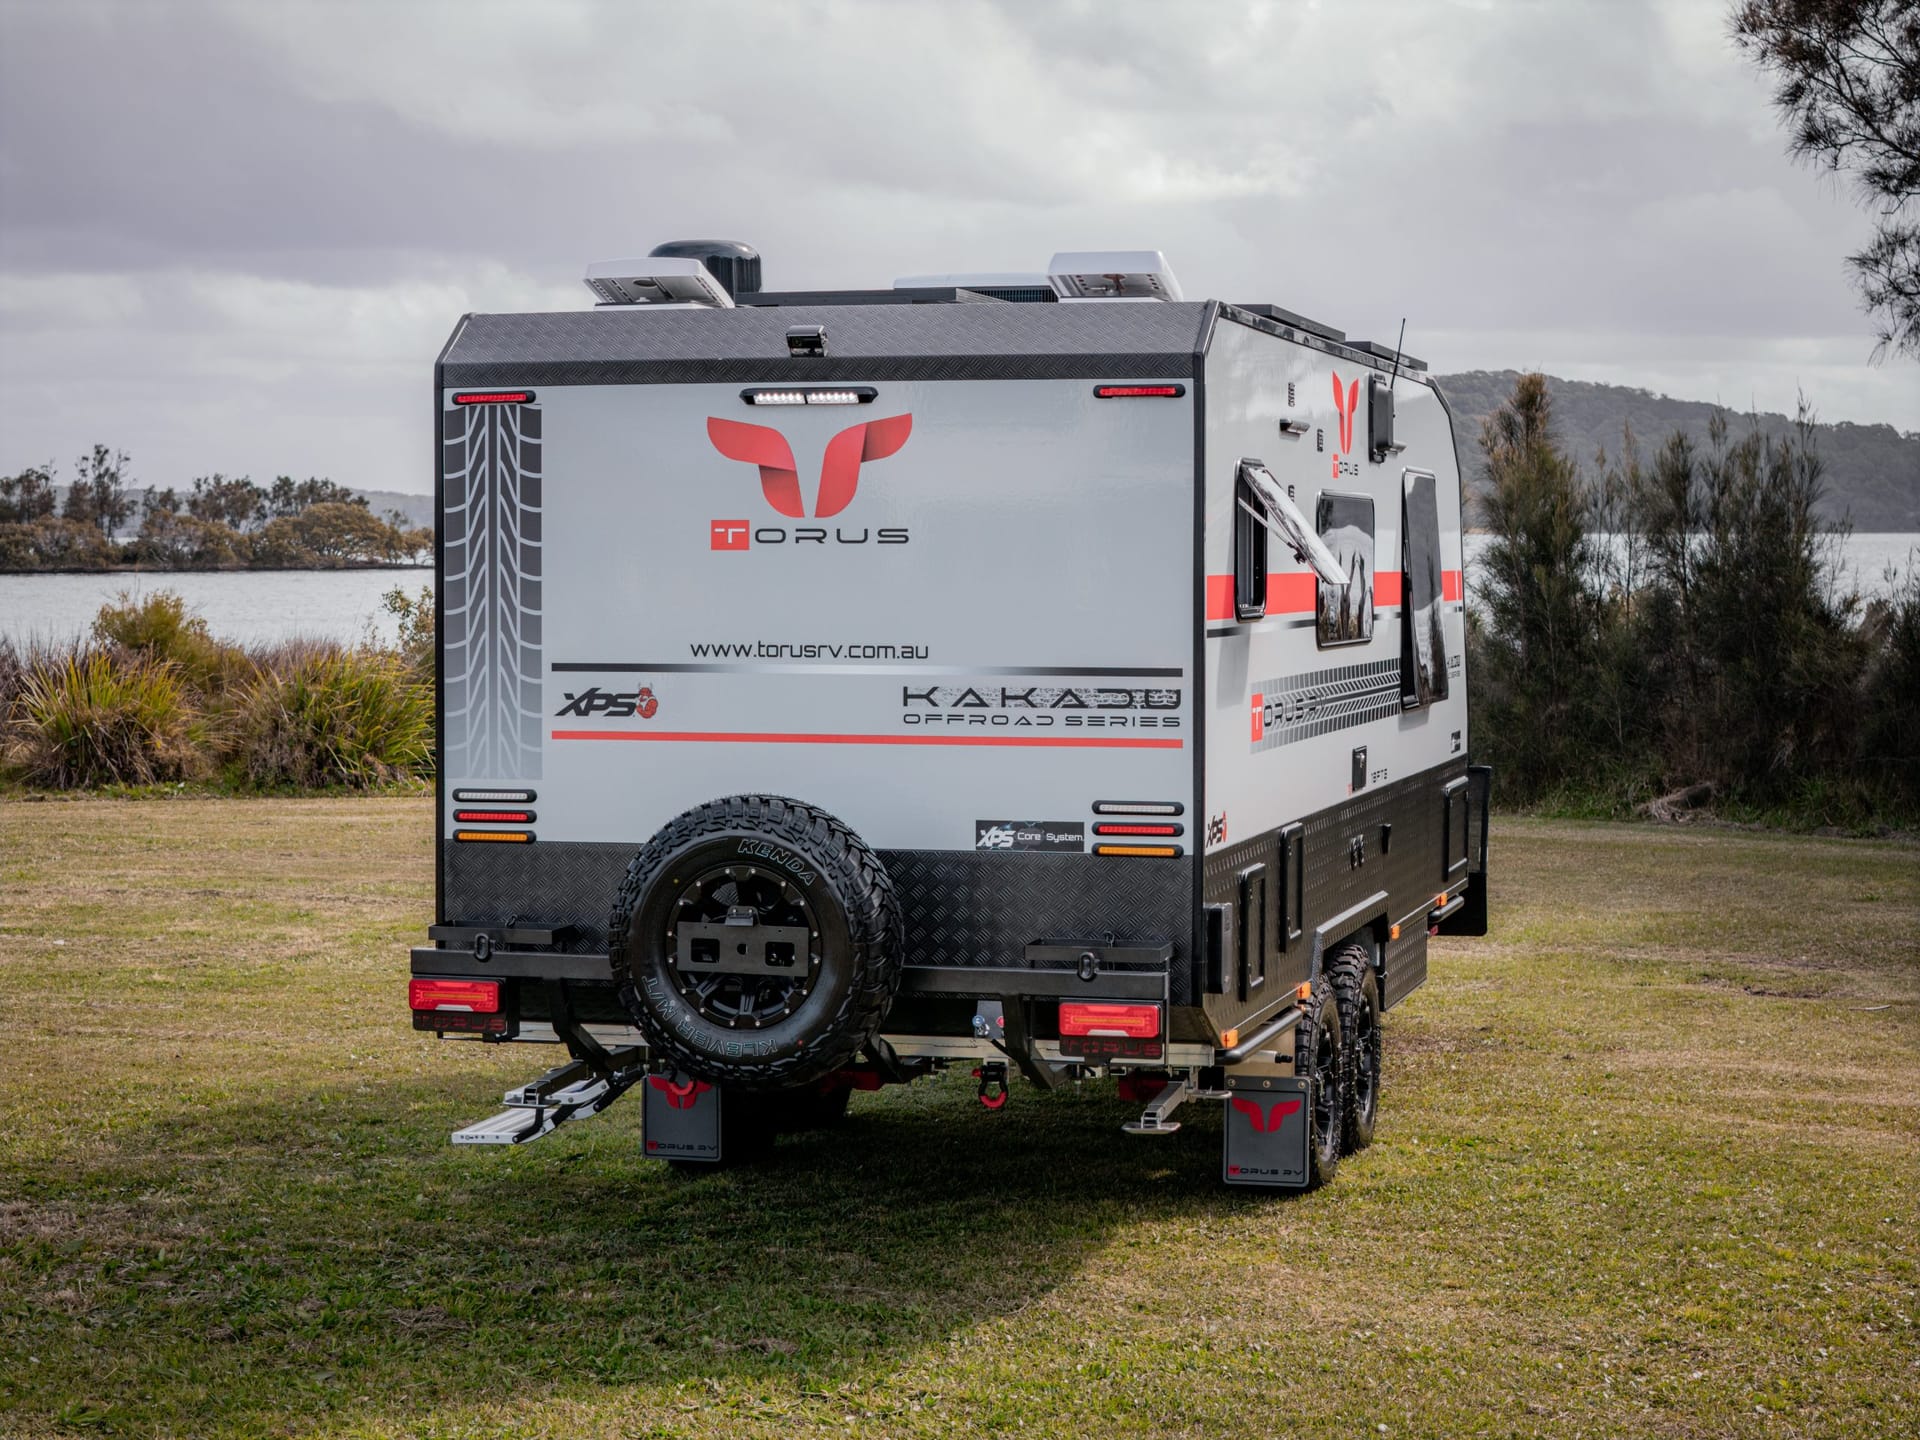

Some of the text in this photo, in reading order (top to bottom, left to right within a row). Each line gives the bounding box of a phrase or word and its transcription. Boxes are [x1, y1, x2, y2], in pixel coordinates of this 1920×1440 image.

[713, 526, 910, 545] TORUS
[690, 640, 929, 659] www.torusrv.com.au
[554, 687, 640, 717] XPS
[902, 686, 1181, 710] KAKADU
[903, 714, 1181, 728] OFFROAD SERIES
[1252, 697, 1304, 735] TORUS
[976, 826, 1083, 847] XPS Core System
[737, 838, 815, 887] KENDA
[415, 1015, 506, 1031] TORUS
[640, 975, 778, 1058] KLEVER M/T
[1062, 1039, 1161, 1056] TORUS
[1230, 1165, 1303, 1175] TORUS RV
